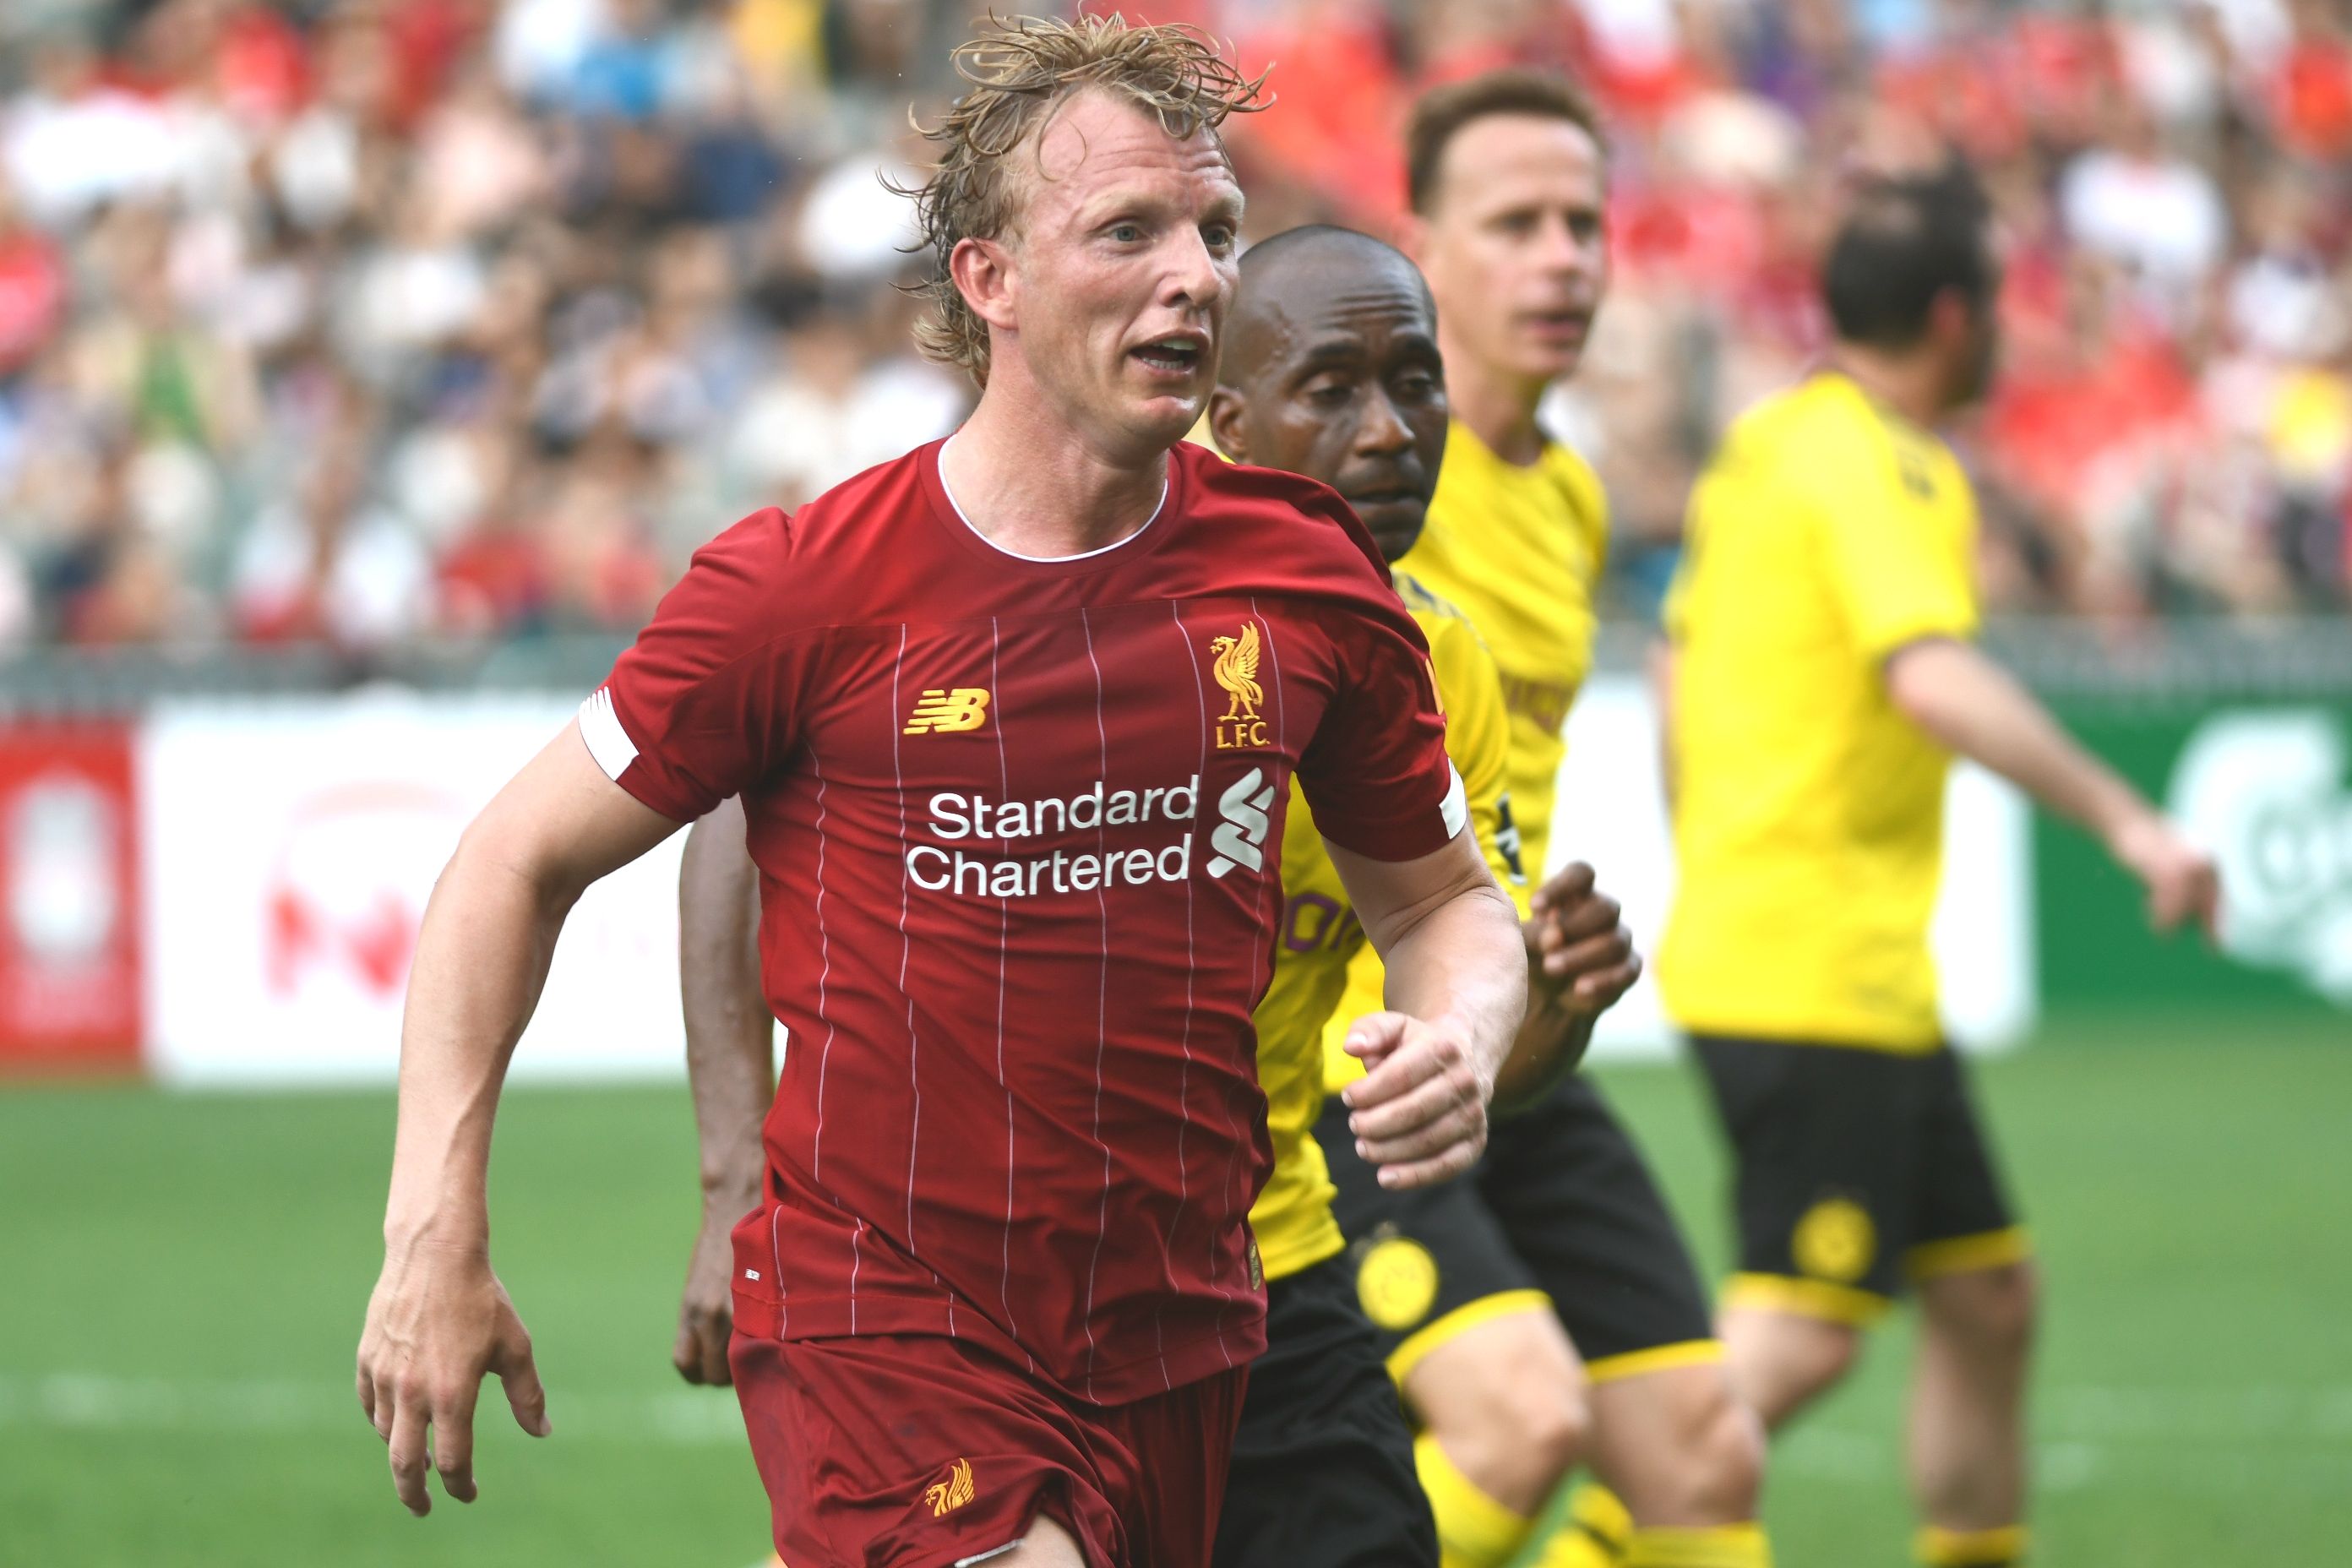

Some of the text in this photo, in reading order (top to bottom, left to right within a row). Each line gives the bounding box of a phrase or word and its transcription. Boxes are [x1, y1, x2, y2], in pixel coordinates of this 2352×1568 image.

[902, 688, 991, 734] NB
[928, 774, 1200, 840] Standard
[906, 833, 1192, 897] Chartered
